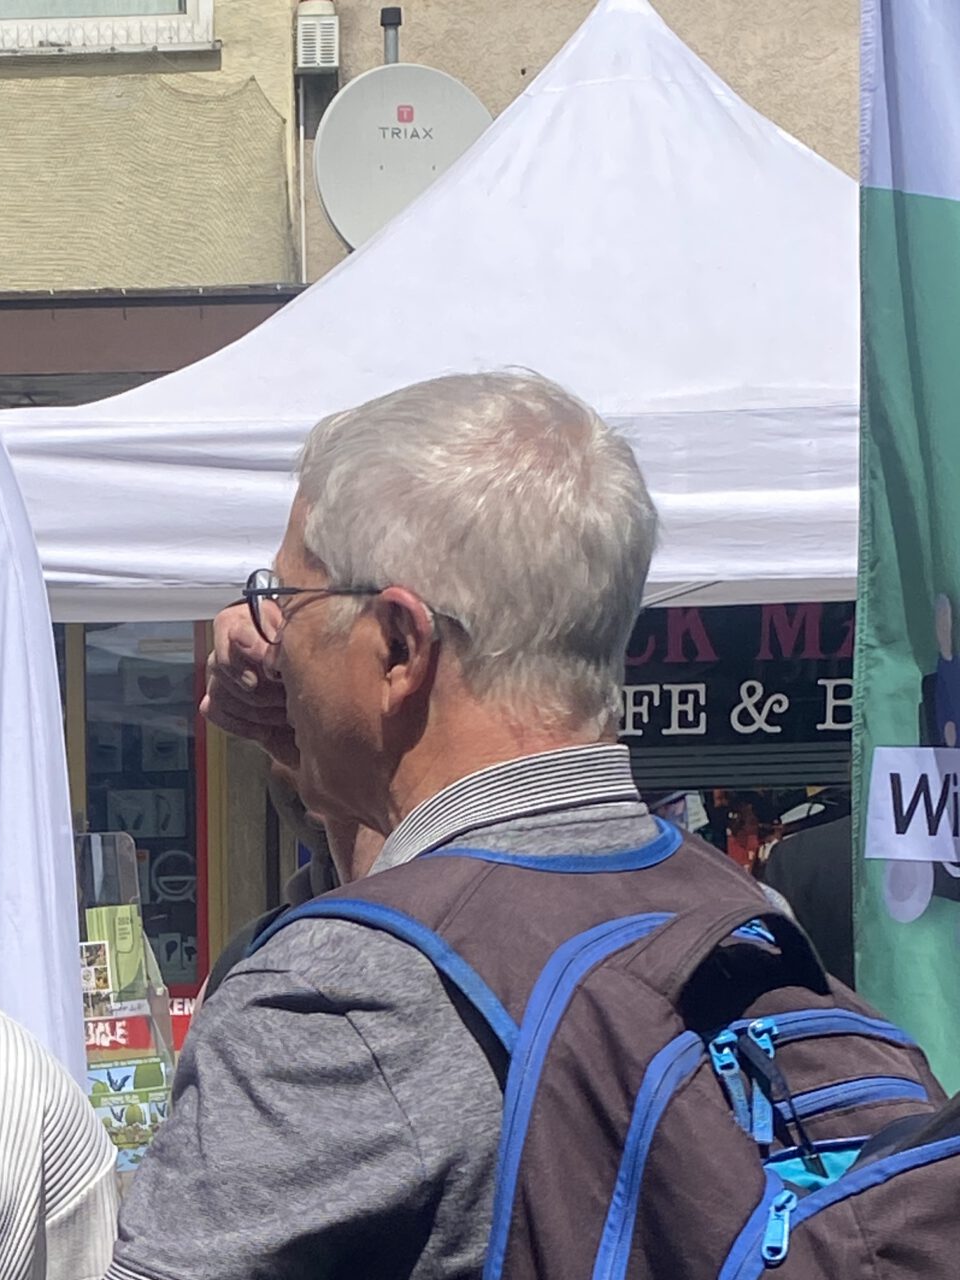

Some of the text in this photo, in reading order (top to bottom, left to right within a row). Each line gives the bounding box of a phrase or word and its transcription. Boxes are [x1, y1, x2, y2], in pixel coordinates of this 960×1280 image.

[377, 126, 434, 140] TRIAX
[729, 679, 790, 734] &
[889, 772, 959, 838] Wi
